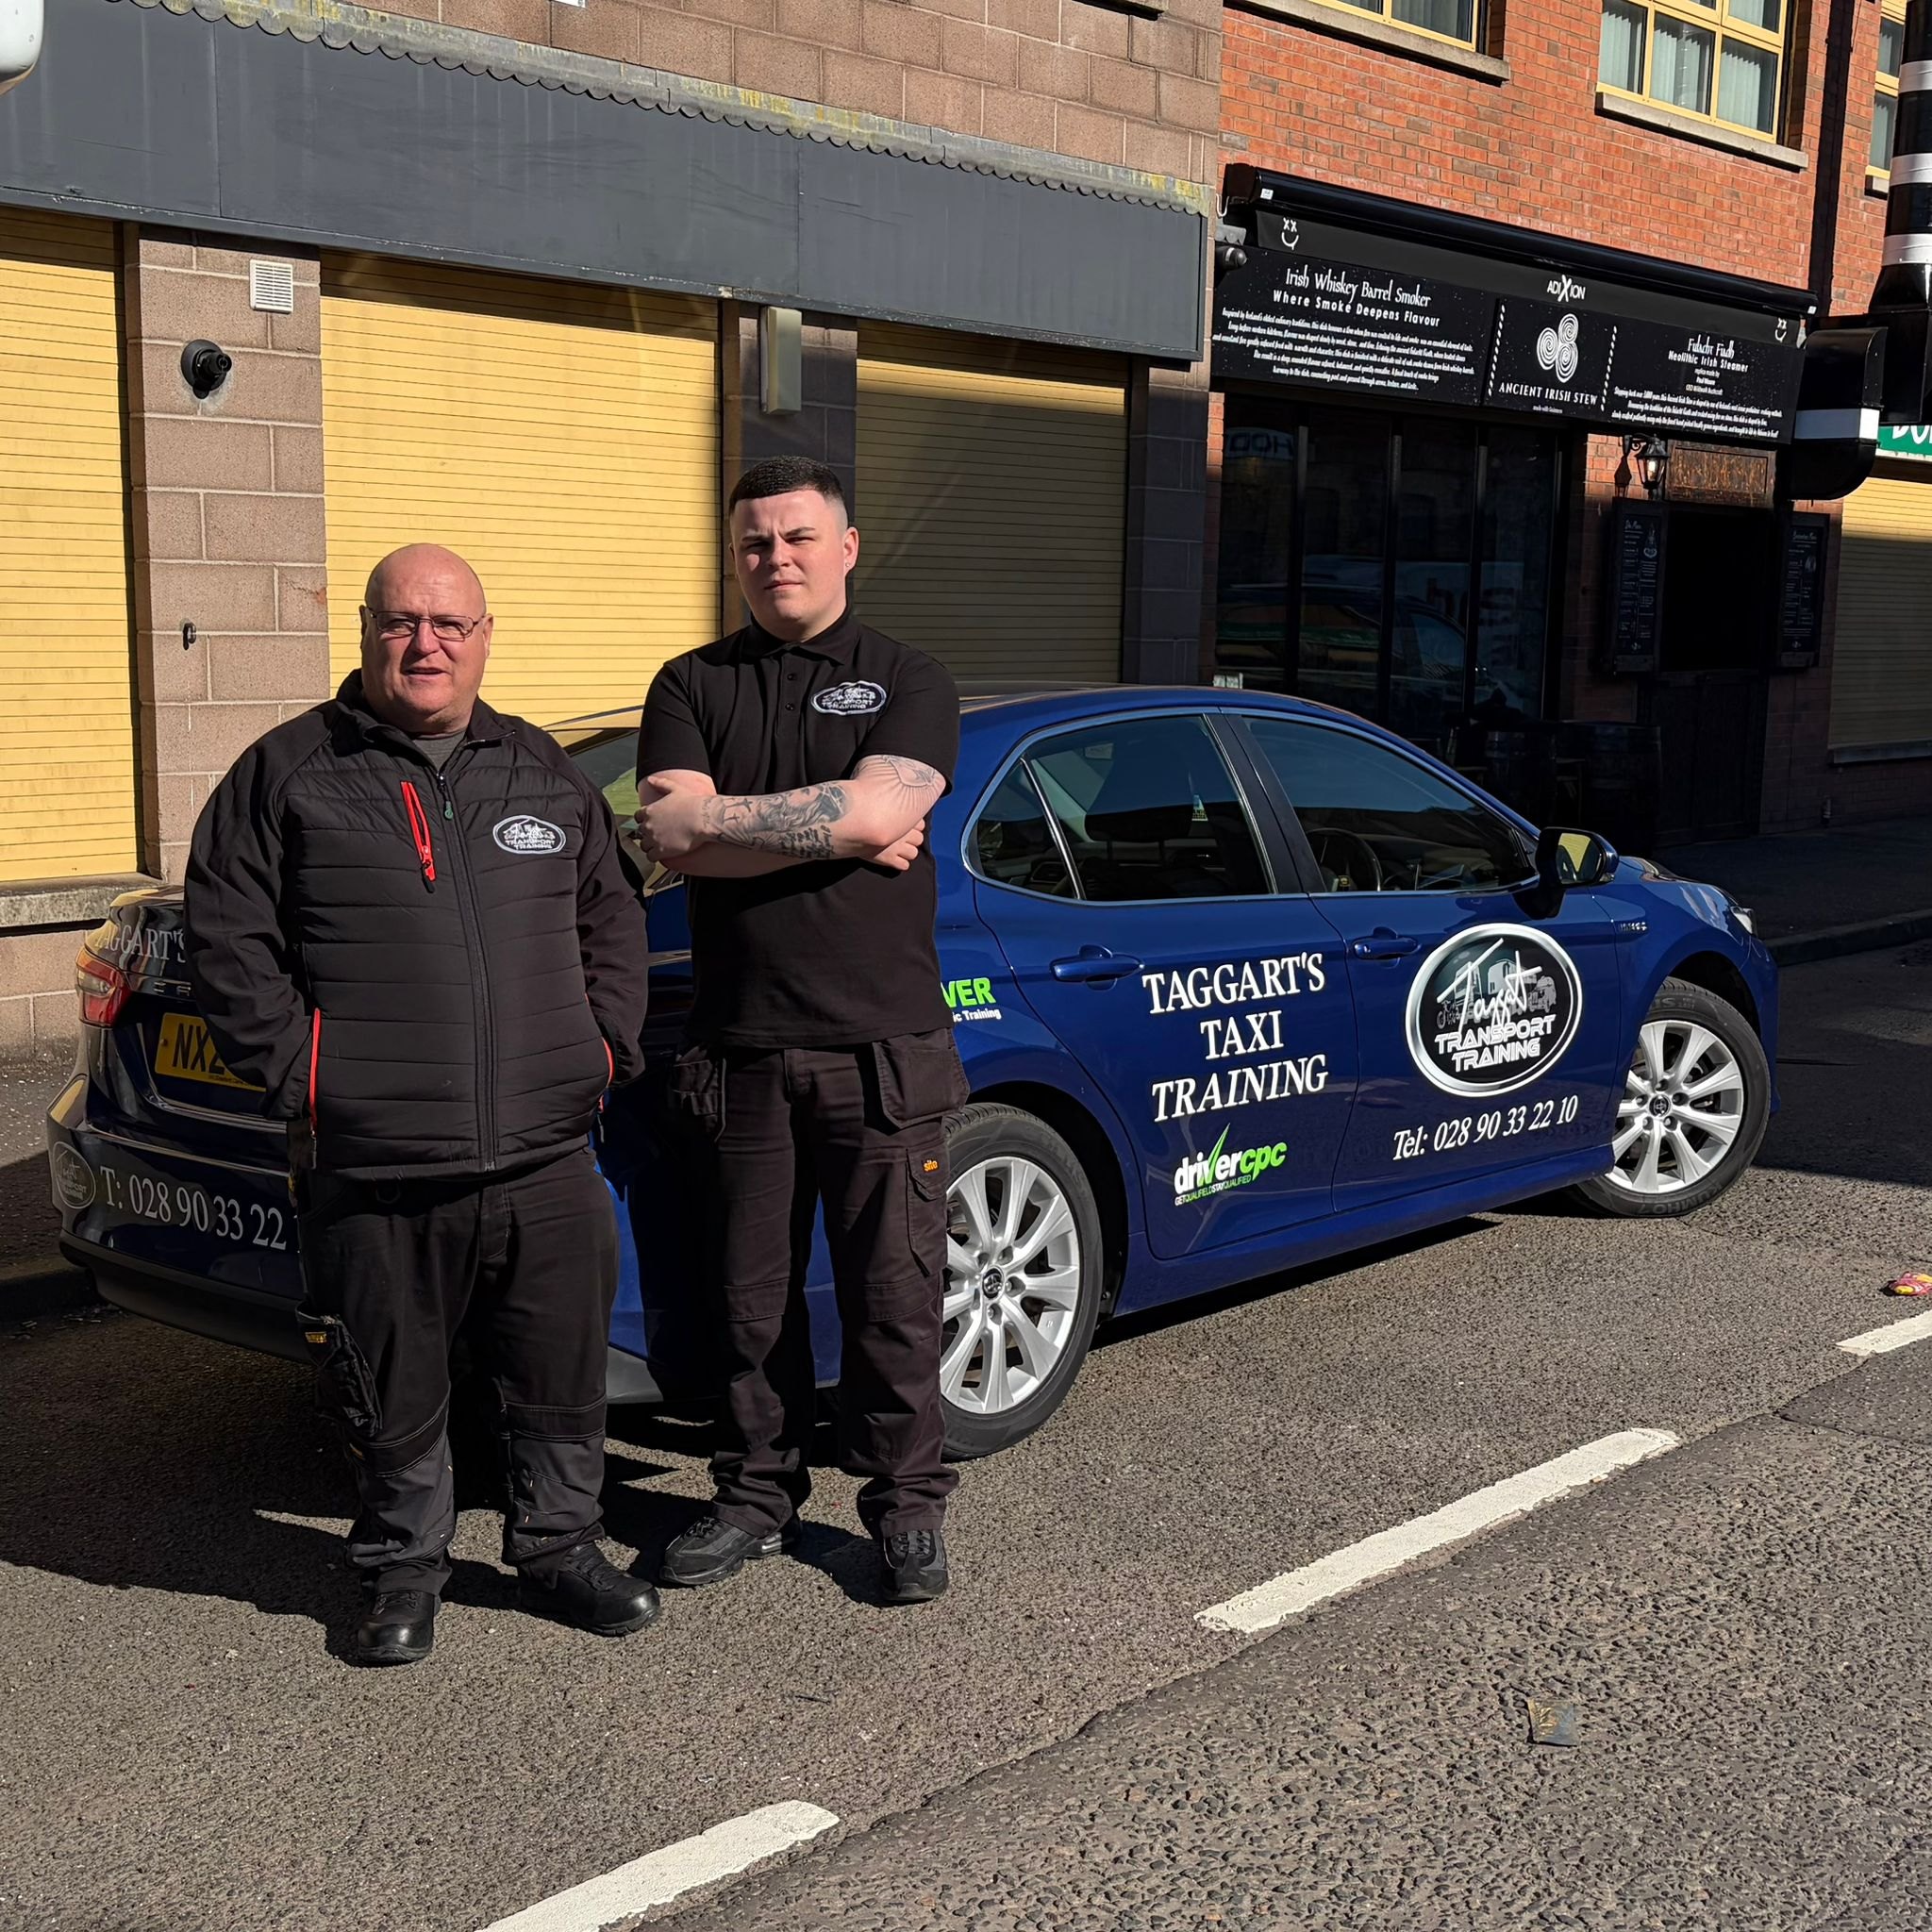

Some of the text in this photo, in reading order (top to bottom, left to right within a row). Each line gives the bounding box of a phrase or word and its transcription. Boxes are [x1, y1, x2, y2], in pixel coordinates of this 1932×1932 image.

[1285, 264, 1431, 308] Irish Whiskey Barrel Smoker
[1273, 290, 1441, 327] Where Smoke Deepens Flavour
[1668, 350, 1749, 373] Neolithic Irish Steamer
[1498, 382, 1542, 398] ANCIENT
[1544, 388, 1571, 402] IRISH
[1574, 391, 1598, 406] STEW
[941, 977, 996, 1008] VER
[1141, 951, 1325, 1014] TAGGART'S
[962, 1008, 1002, 1021] Training
[1200, 1009, 1285, 1060] TAXI
[1434, 1013, 1557, 1055] TRANSPORT
[1451, 1036, 1541, 1073] TRAINING
[1152, 1054, 1329, 1123] TRAINING
[1392, 1094, 1579, 1161] Tel: 028 90 33 22 10
[100, 1165, 124, 1210] T:
[128, 1174, 173, 1224] 028
[176, 1187, 209, 1232] 90
[213, 1194, 244, 1241] 33
[250, 1203, 288, 1251] 22
